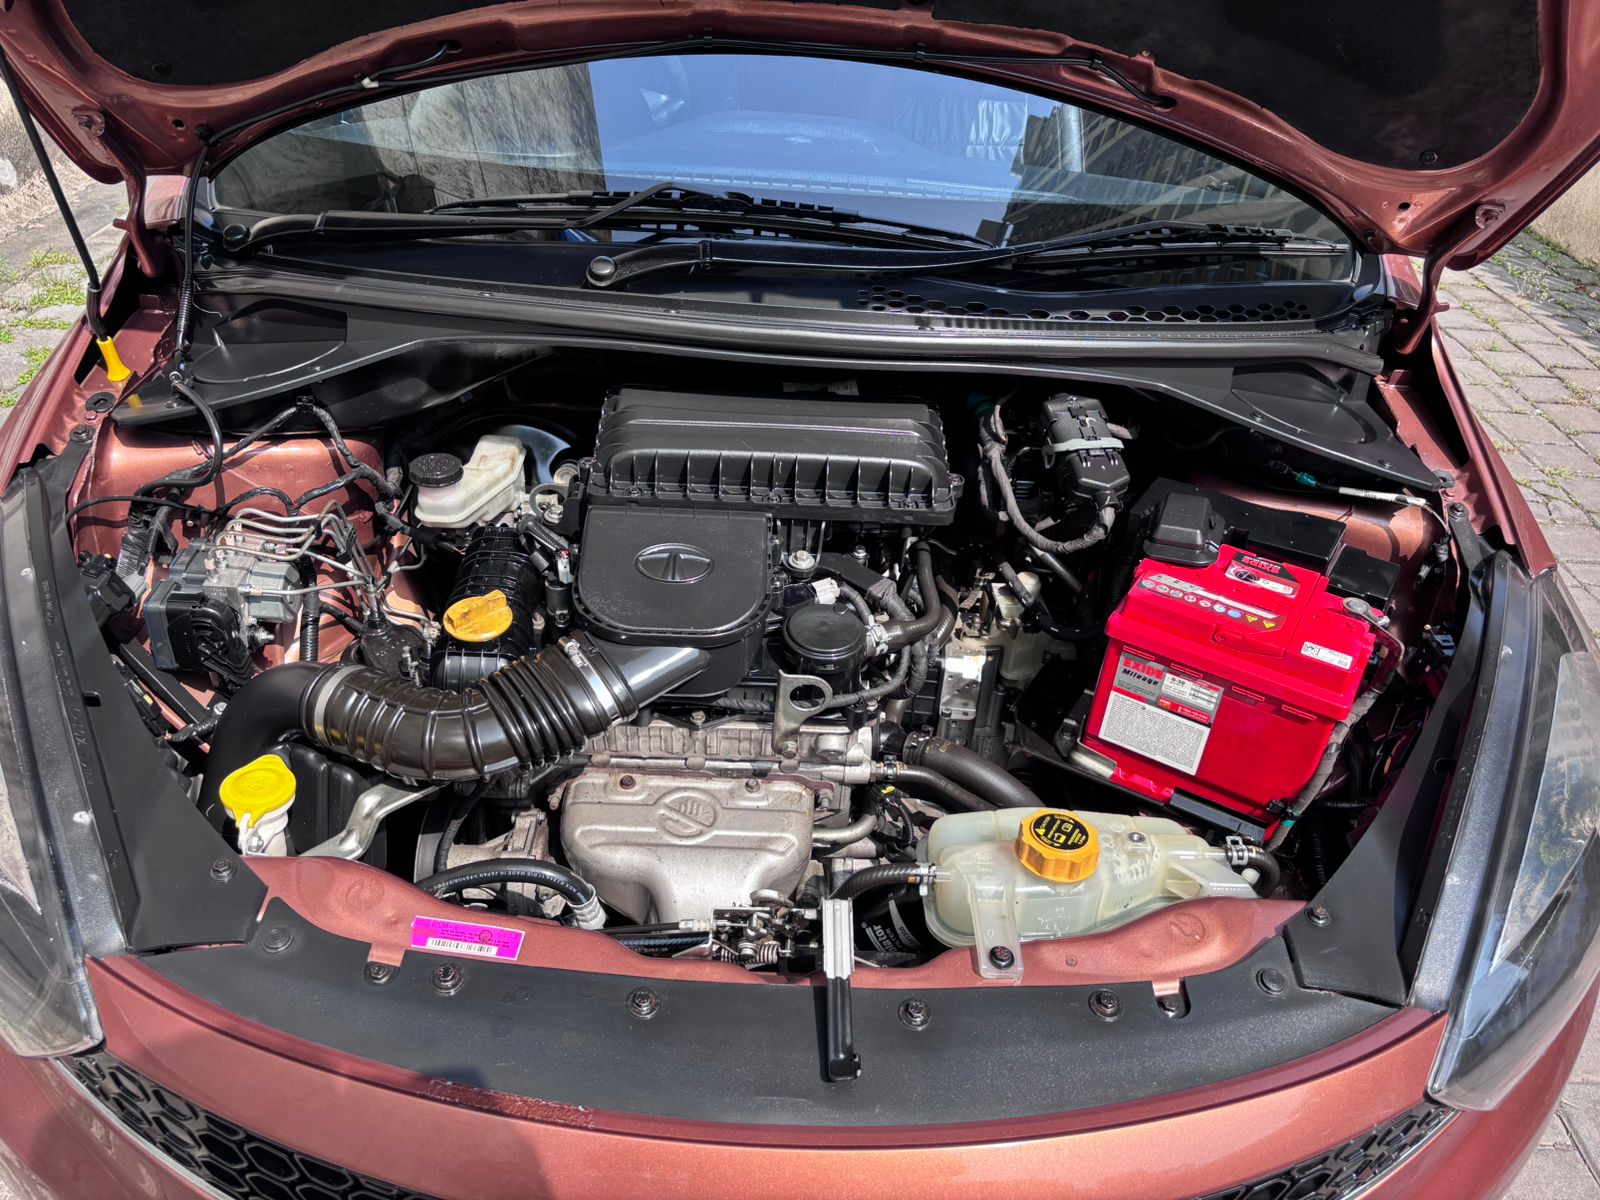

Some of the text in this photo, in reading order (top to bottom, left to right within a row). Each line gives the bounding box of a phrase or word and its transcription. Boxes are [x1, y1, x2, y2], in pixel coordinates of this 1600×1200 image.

[1122, 668, 1159, 686] Mileage
[1123, 657, 1164, 680] EXIDE
[872, 925, 898, 952] olator
